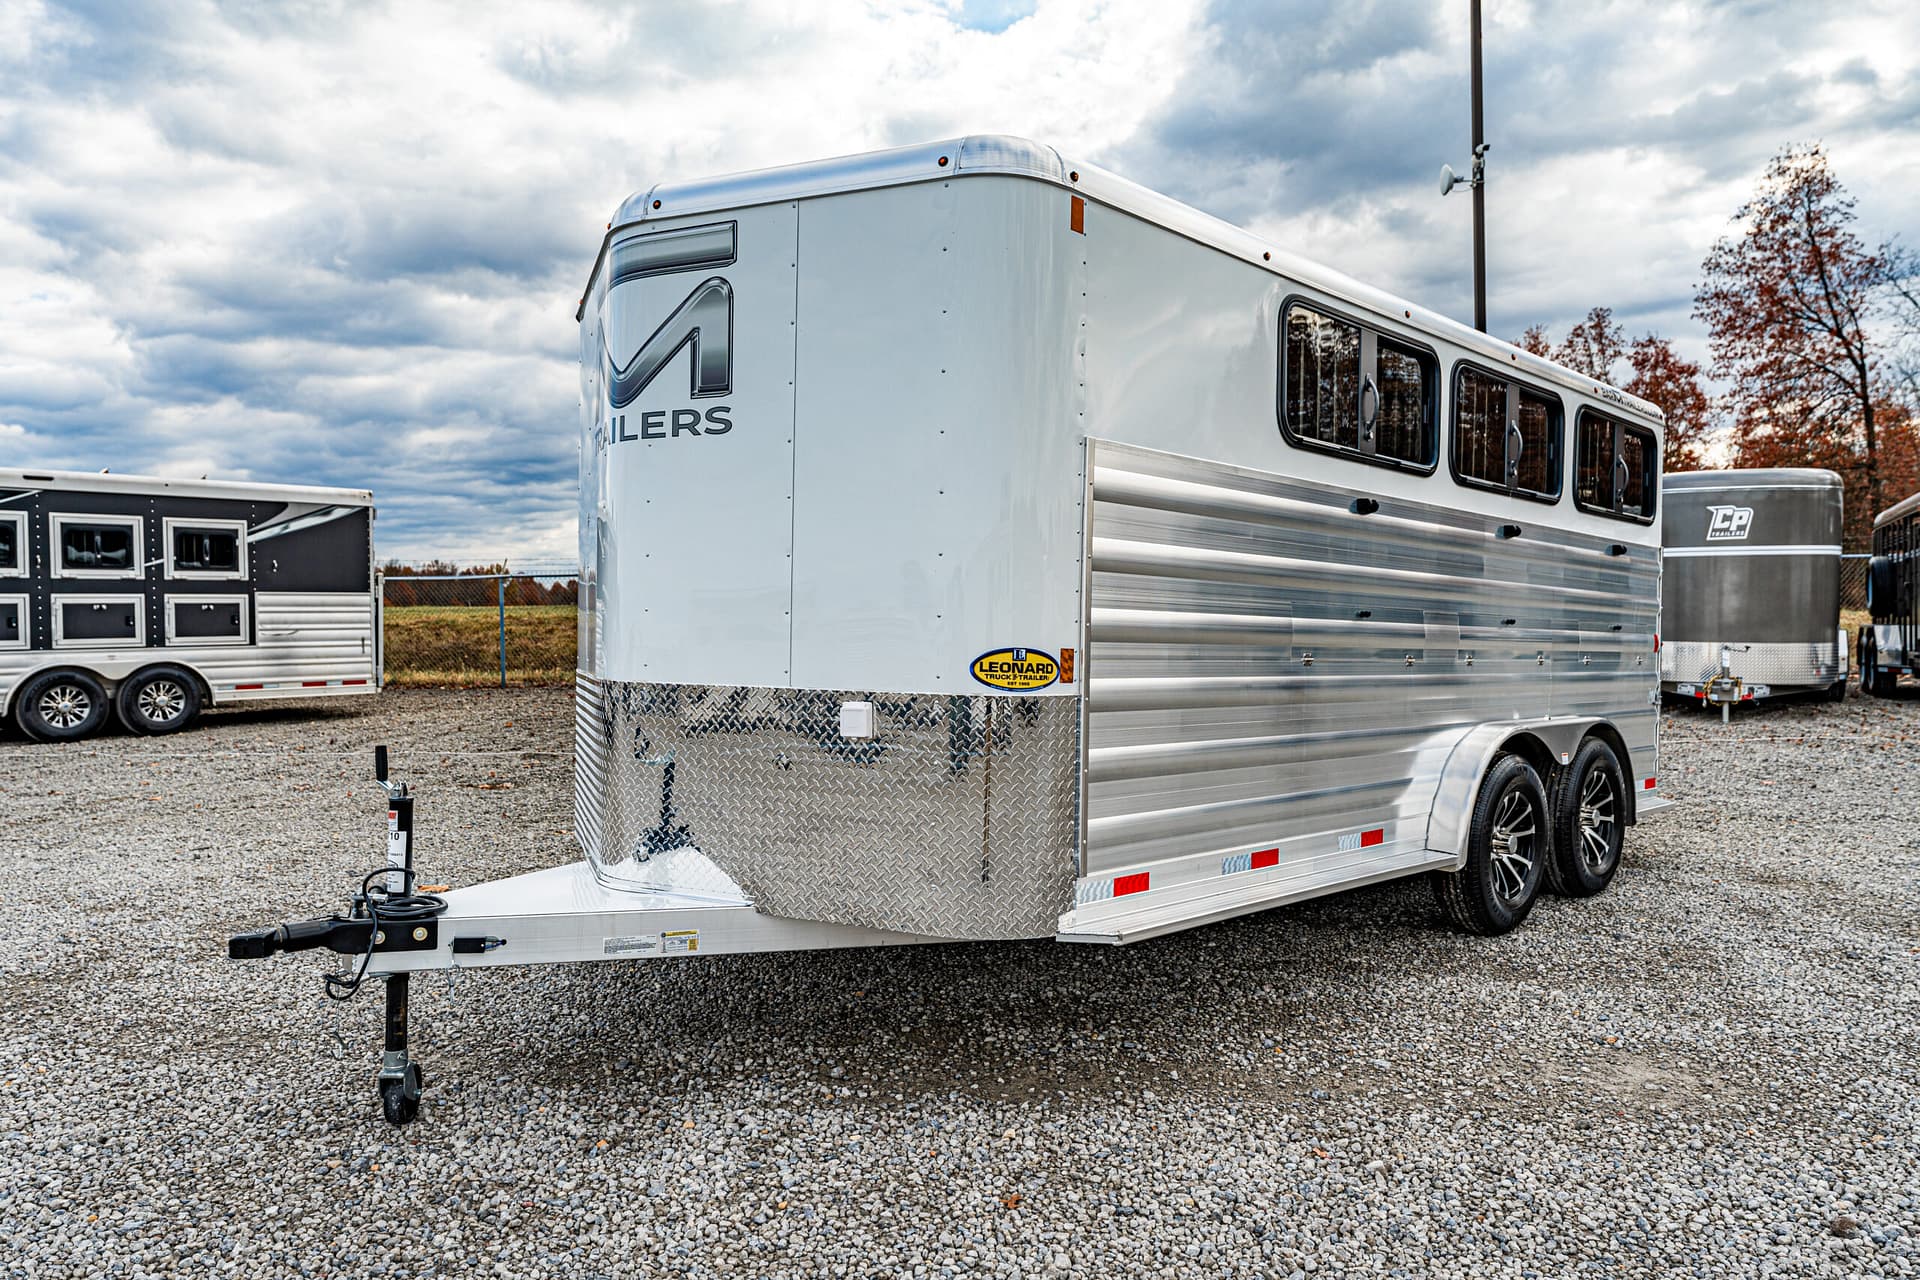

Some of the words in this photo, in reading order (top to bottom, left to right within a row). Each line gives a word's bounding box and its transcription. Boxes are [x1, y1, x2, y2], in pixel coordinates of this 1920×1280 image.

[1713, 508, 1750, 531] CP
[979, 661, 1054, 674] LEONARD
[984, 673, 1011, 681] TRUCK
